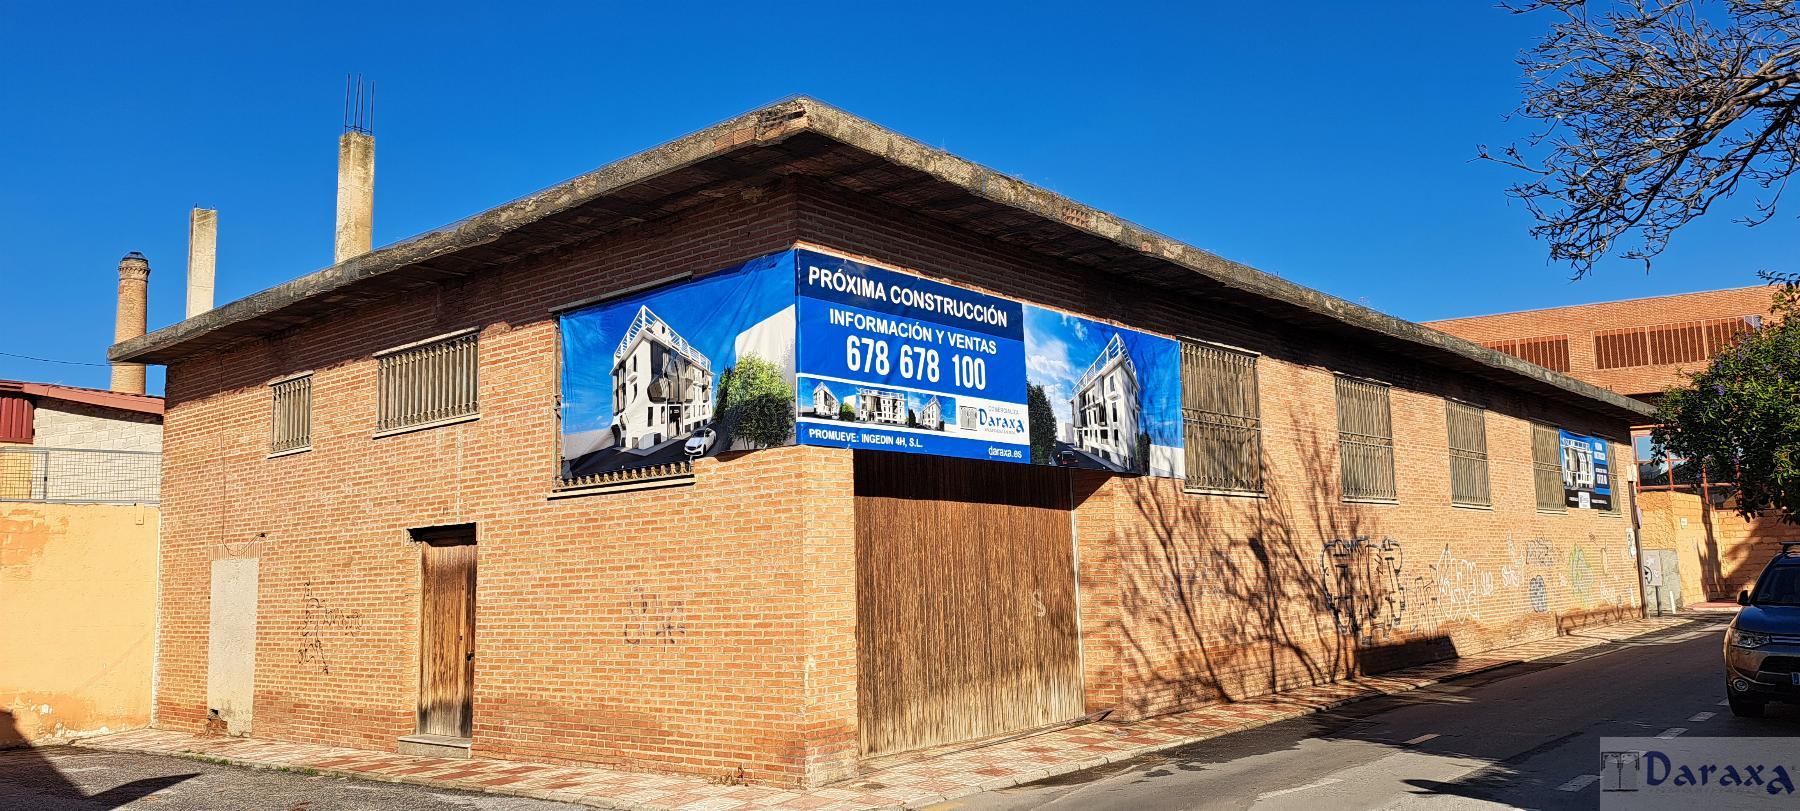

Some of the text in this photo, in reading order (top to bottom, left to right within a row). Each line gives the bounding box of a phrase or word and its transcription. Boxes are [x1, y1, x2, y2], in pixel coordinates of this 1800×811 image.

[808, 265, 1007, 328] PRÓXIMA CONSTRUCCIÓN
[829, 308, 997, 355] INFORMACIÓN Y VENTAS
[846, 335, 986, 390] 678 678 100
[808, 428, 924, 449] PROMUEVE: INGEDIN 4H, S.L.
[988, 445, 1023, 459] daraxa.es
